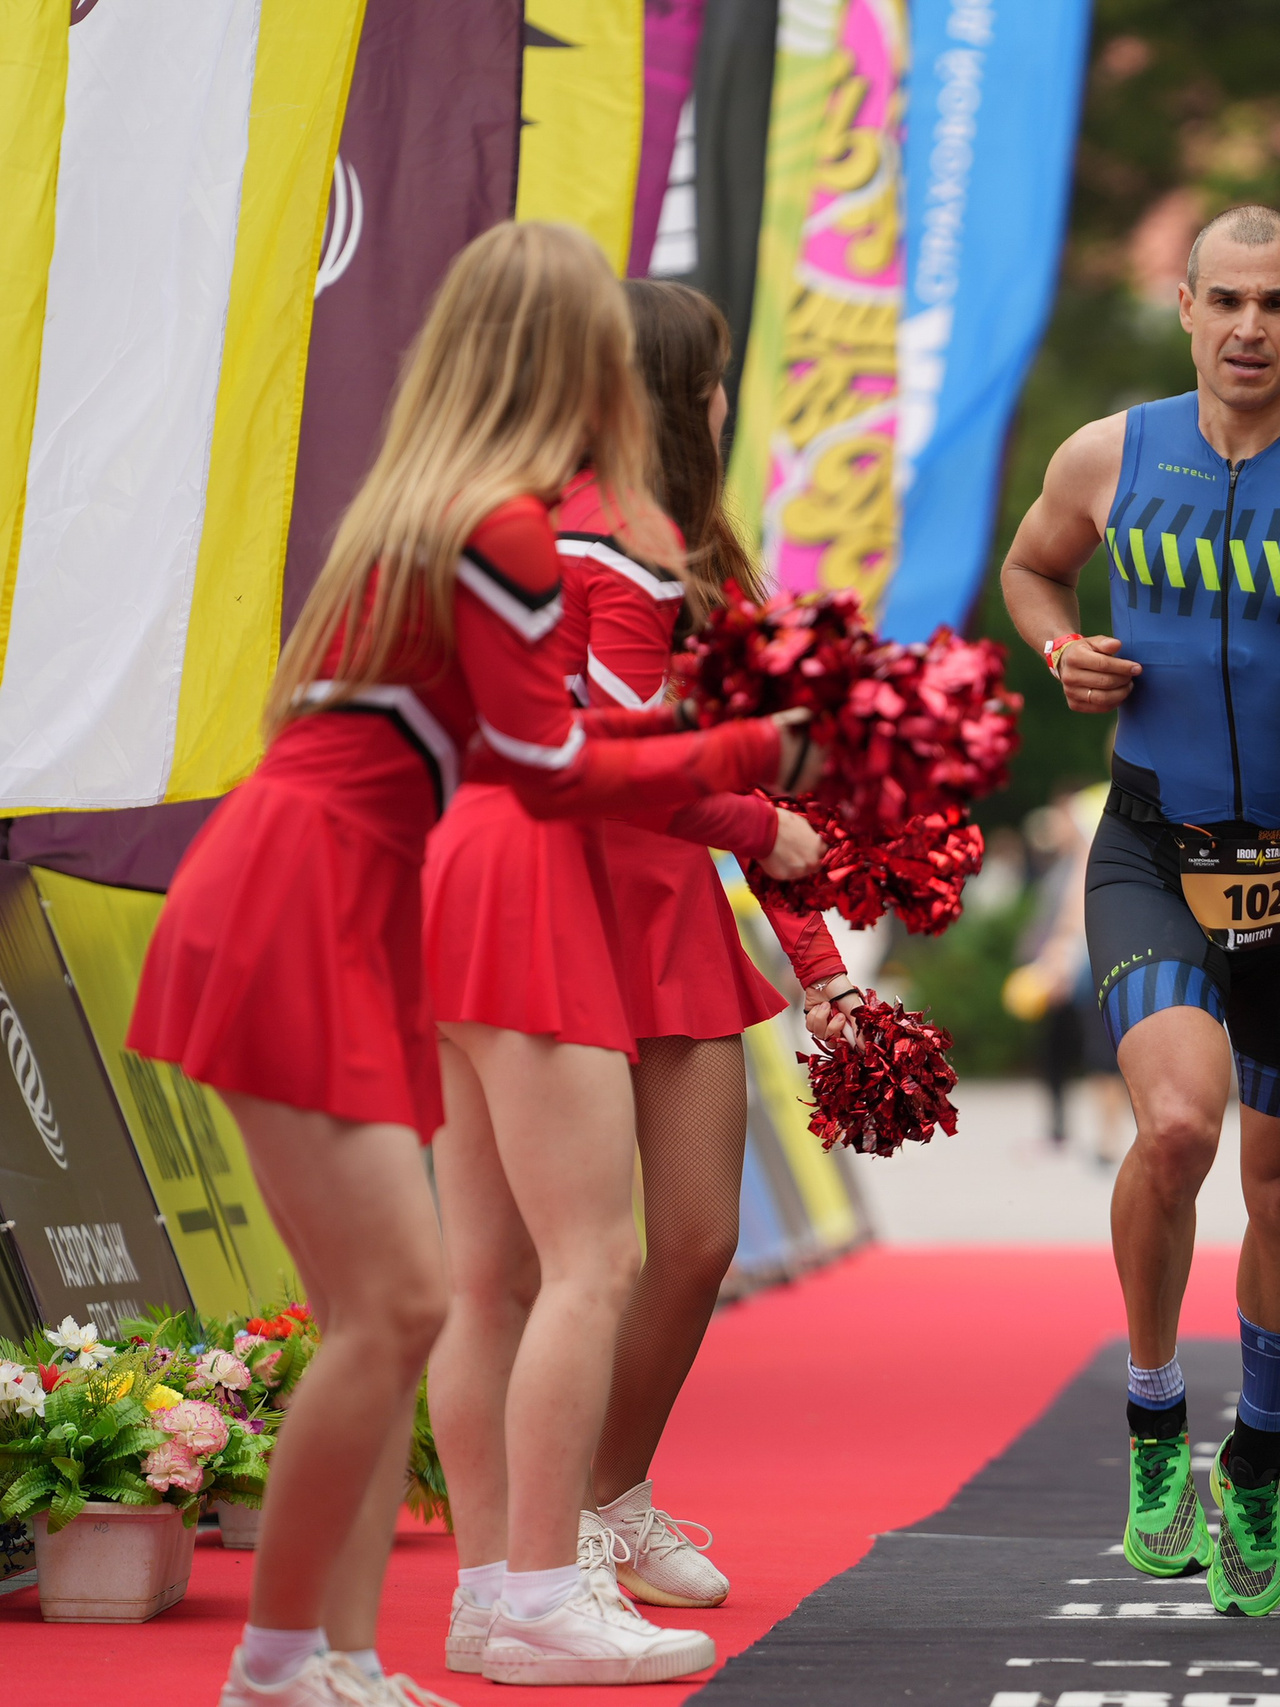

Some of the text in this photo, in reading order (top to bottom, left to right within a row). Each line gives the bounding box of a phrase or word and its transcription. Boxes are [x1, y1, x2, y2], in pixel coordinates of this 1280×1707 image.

[1236, 848, 1257, 859] IRON
[1236, 928, 1274, 944] DMITRIY
[44, 1222, 140, 1288] ГАЗПРОМБАНК
